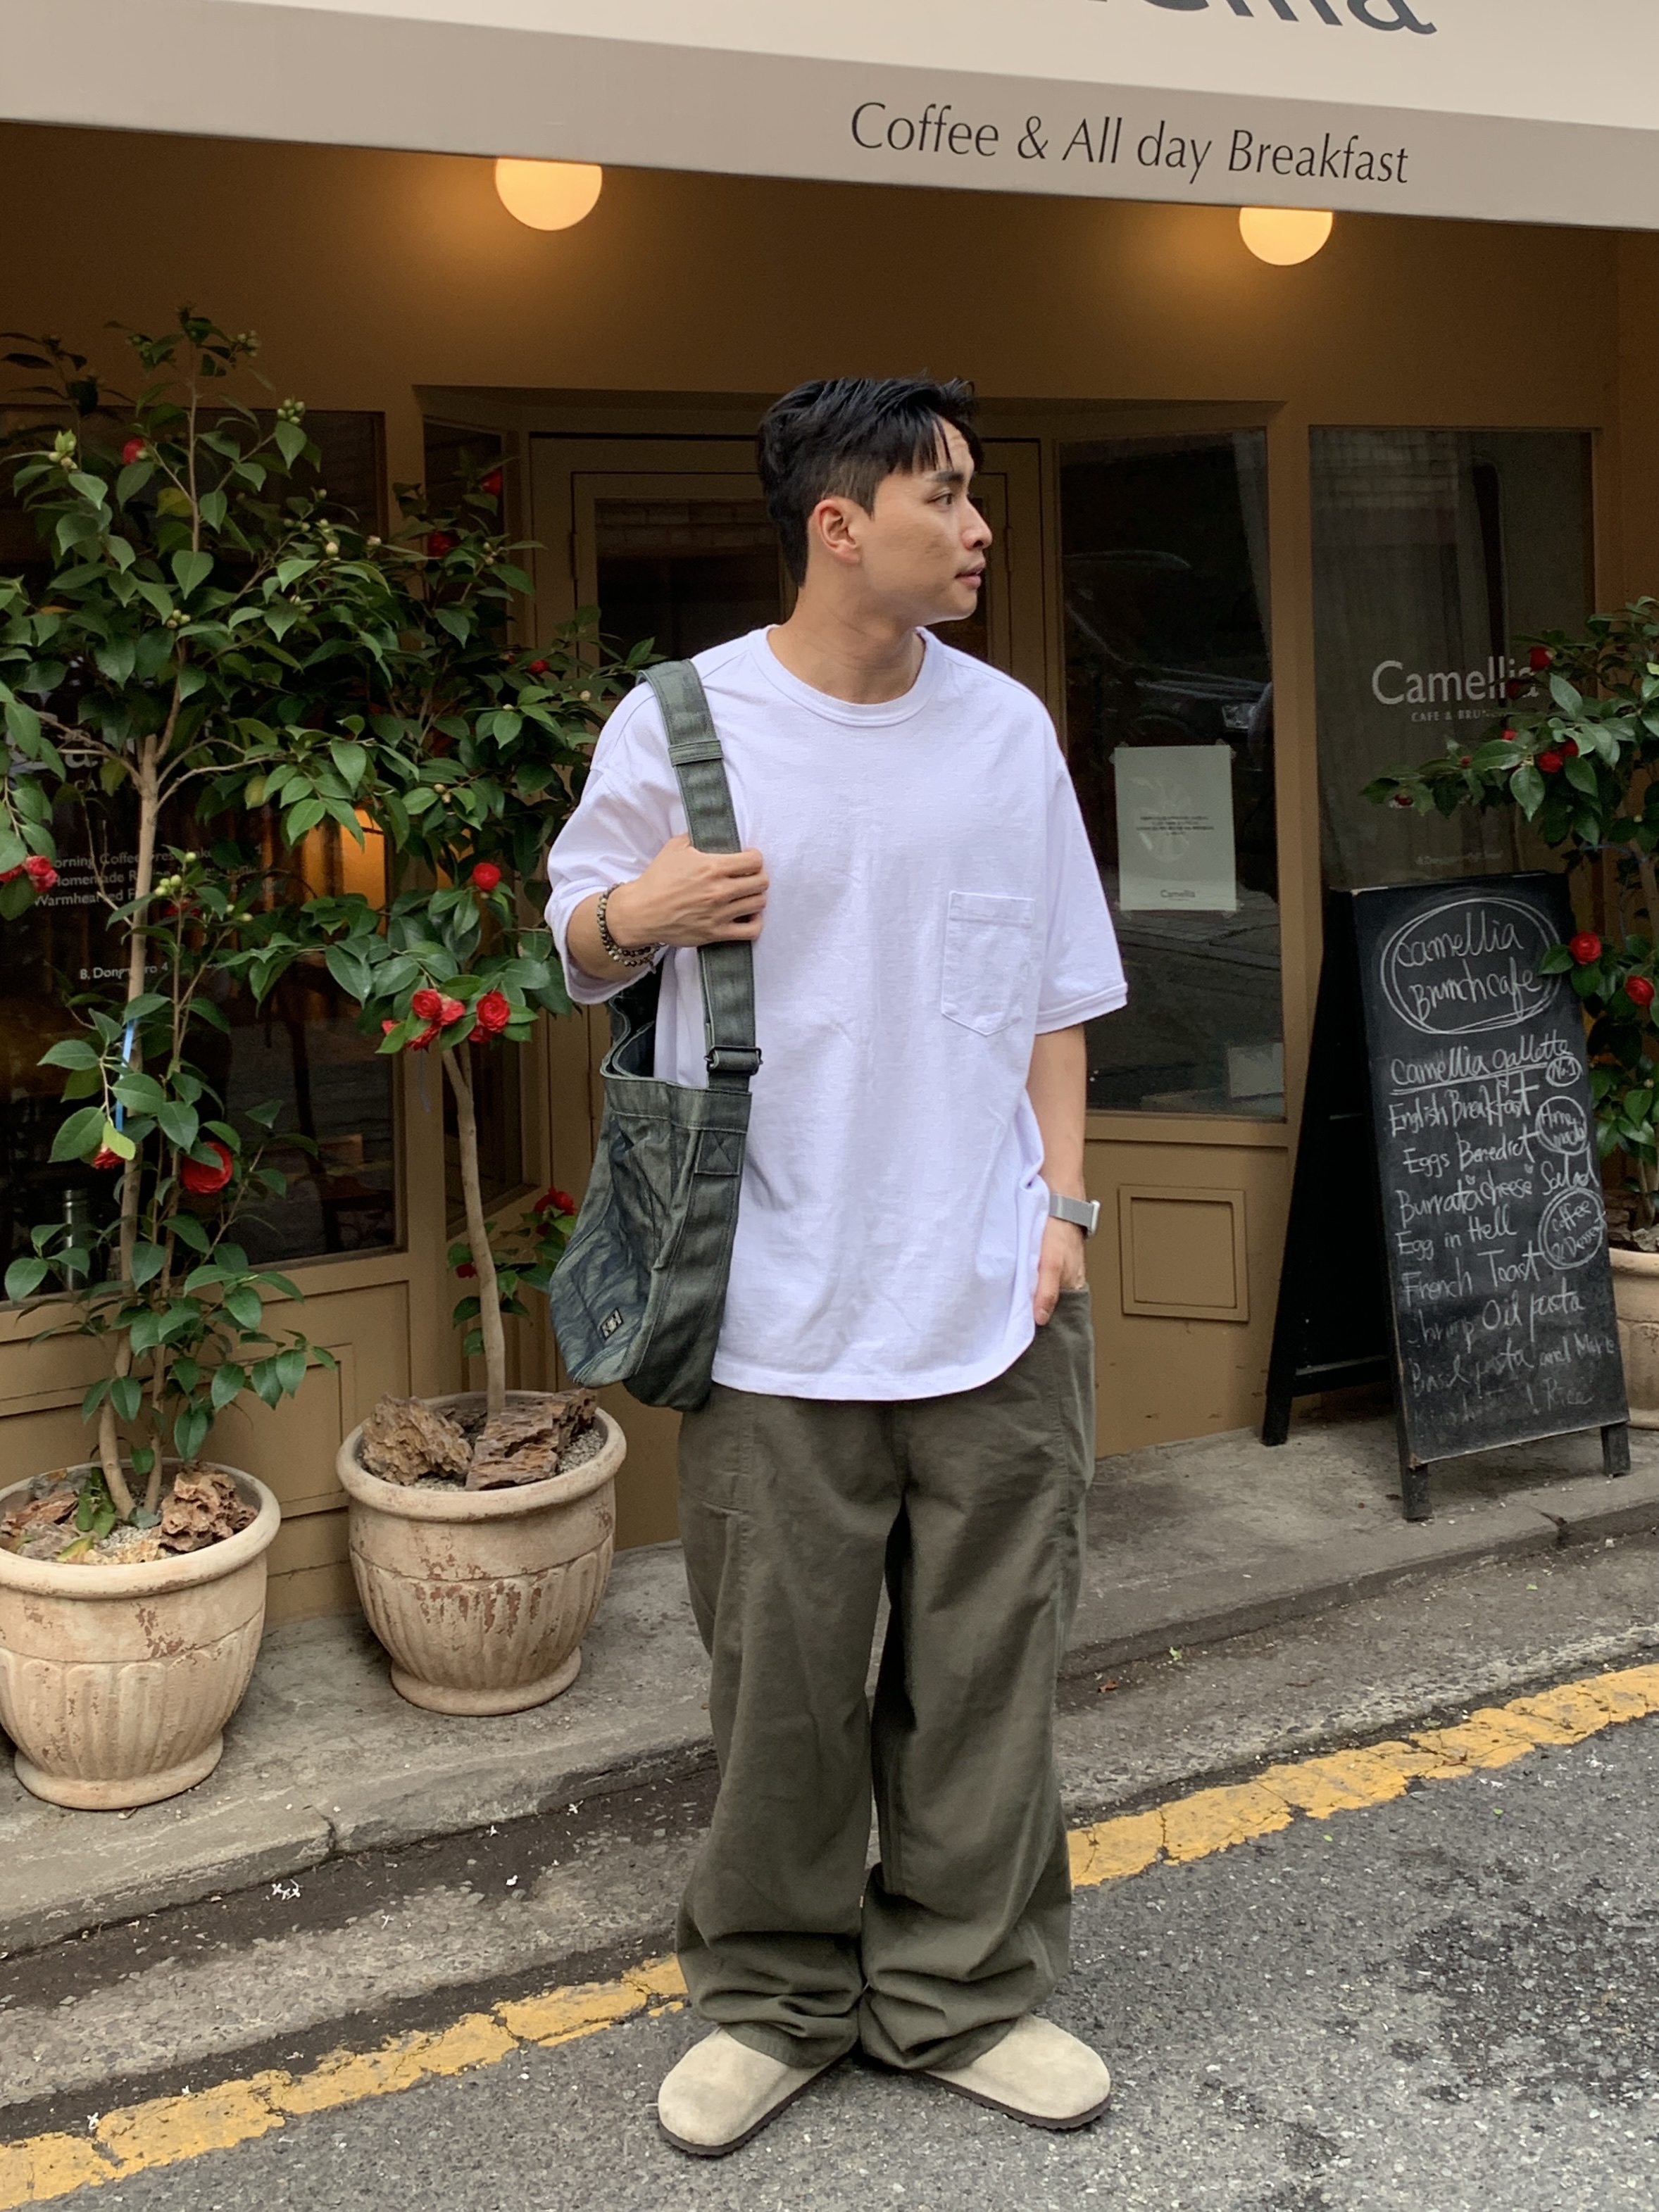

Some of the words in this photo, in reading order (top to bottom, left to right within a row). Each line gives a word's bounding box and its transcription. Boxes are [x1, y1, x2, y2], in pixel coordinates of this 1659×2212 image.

[851, 101, 1000, 157] Coffee
[1018, 115, 1050, 160] &
[1062, 117, 1122, 164] All
[1136, 120, 1212, 184] day
[1228, 129, 1409, 184] Breakfast
[54, 855, 94, 870] orning
[1389, 1093, 1449, 1138] English
[1403, 1147, 1451, 1178] Eggs
[1454, 1124, 1541, 1171] Benedict
[1395, 1231, 1435, 1260] Egg
[1444, 1231, 1462, 1248] in
[1468, 1203, 1517, 1243] Hell
[1401, 1257, 1474, 1307] French
[1477, 1240, 1544, 1288] Toast
[1407, 1309, 1475, 1354] hrimp
[1482, 1290, 1523, 1331] Oil
